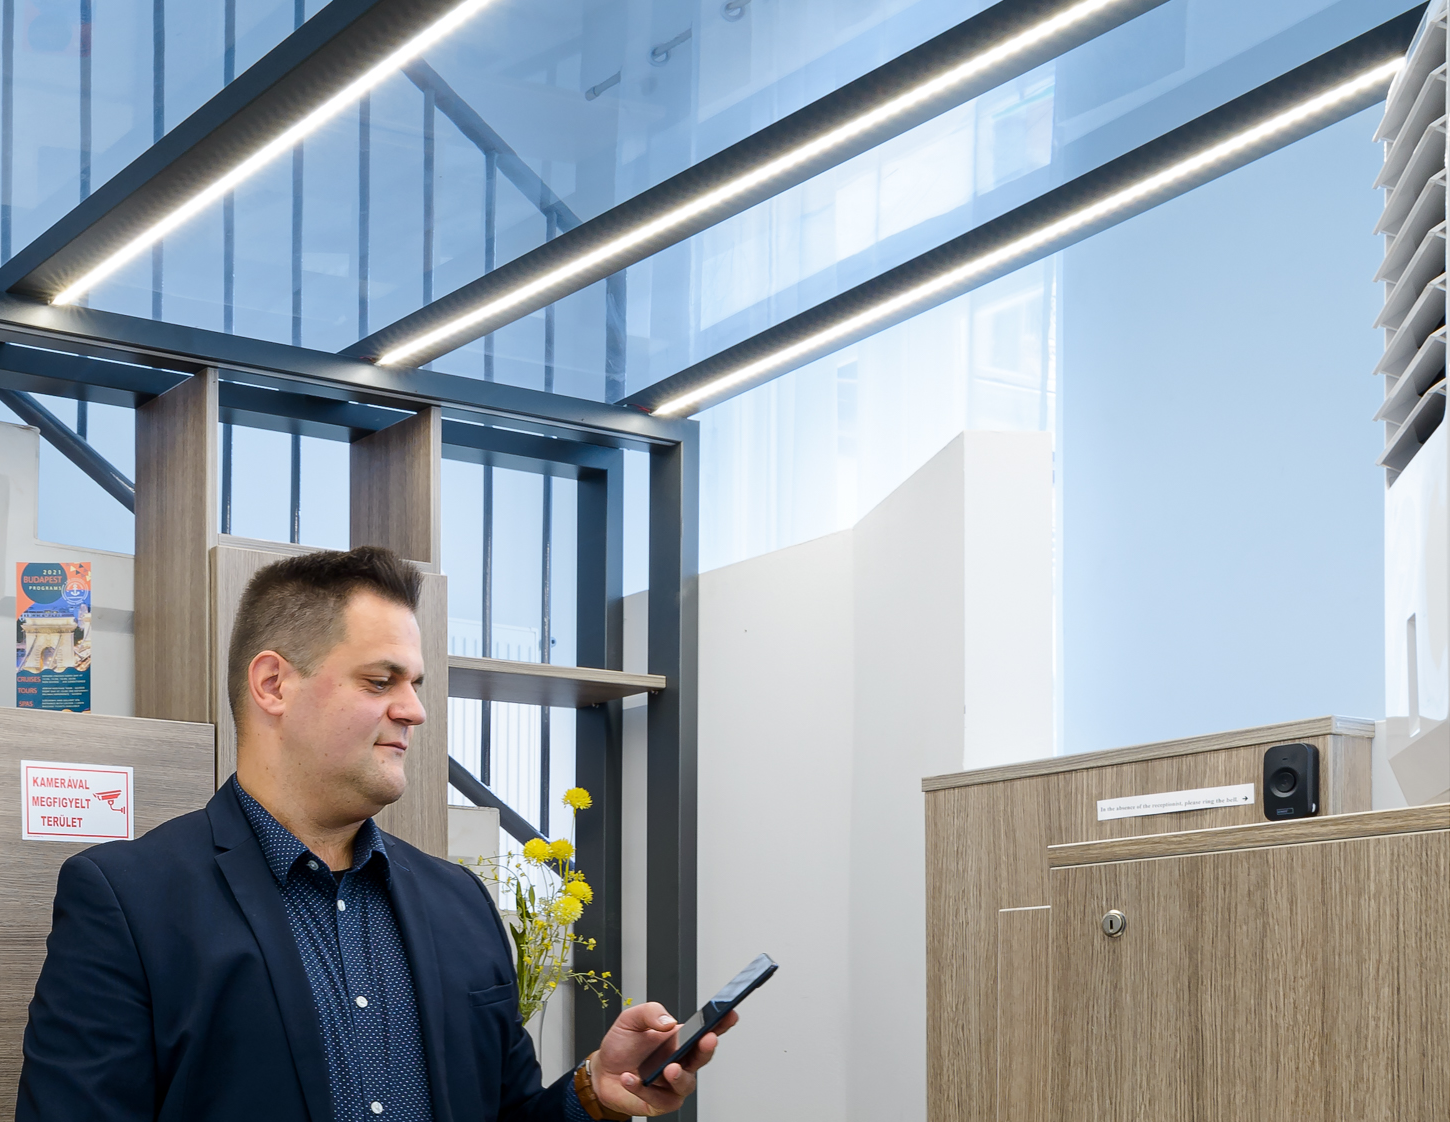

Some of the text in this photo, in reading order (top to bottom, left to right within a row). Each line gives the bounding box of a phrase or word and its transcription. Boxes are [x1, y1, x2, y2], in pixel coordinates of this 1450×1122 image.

[23, 575, 63, 584] BUDAPEST
[32, 775, 90, 790] KAMERÁVAL
[31, 795, 91, 809] MEGFIGYELT
[40, 814, 83, 828] TERÜLET
